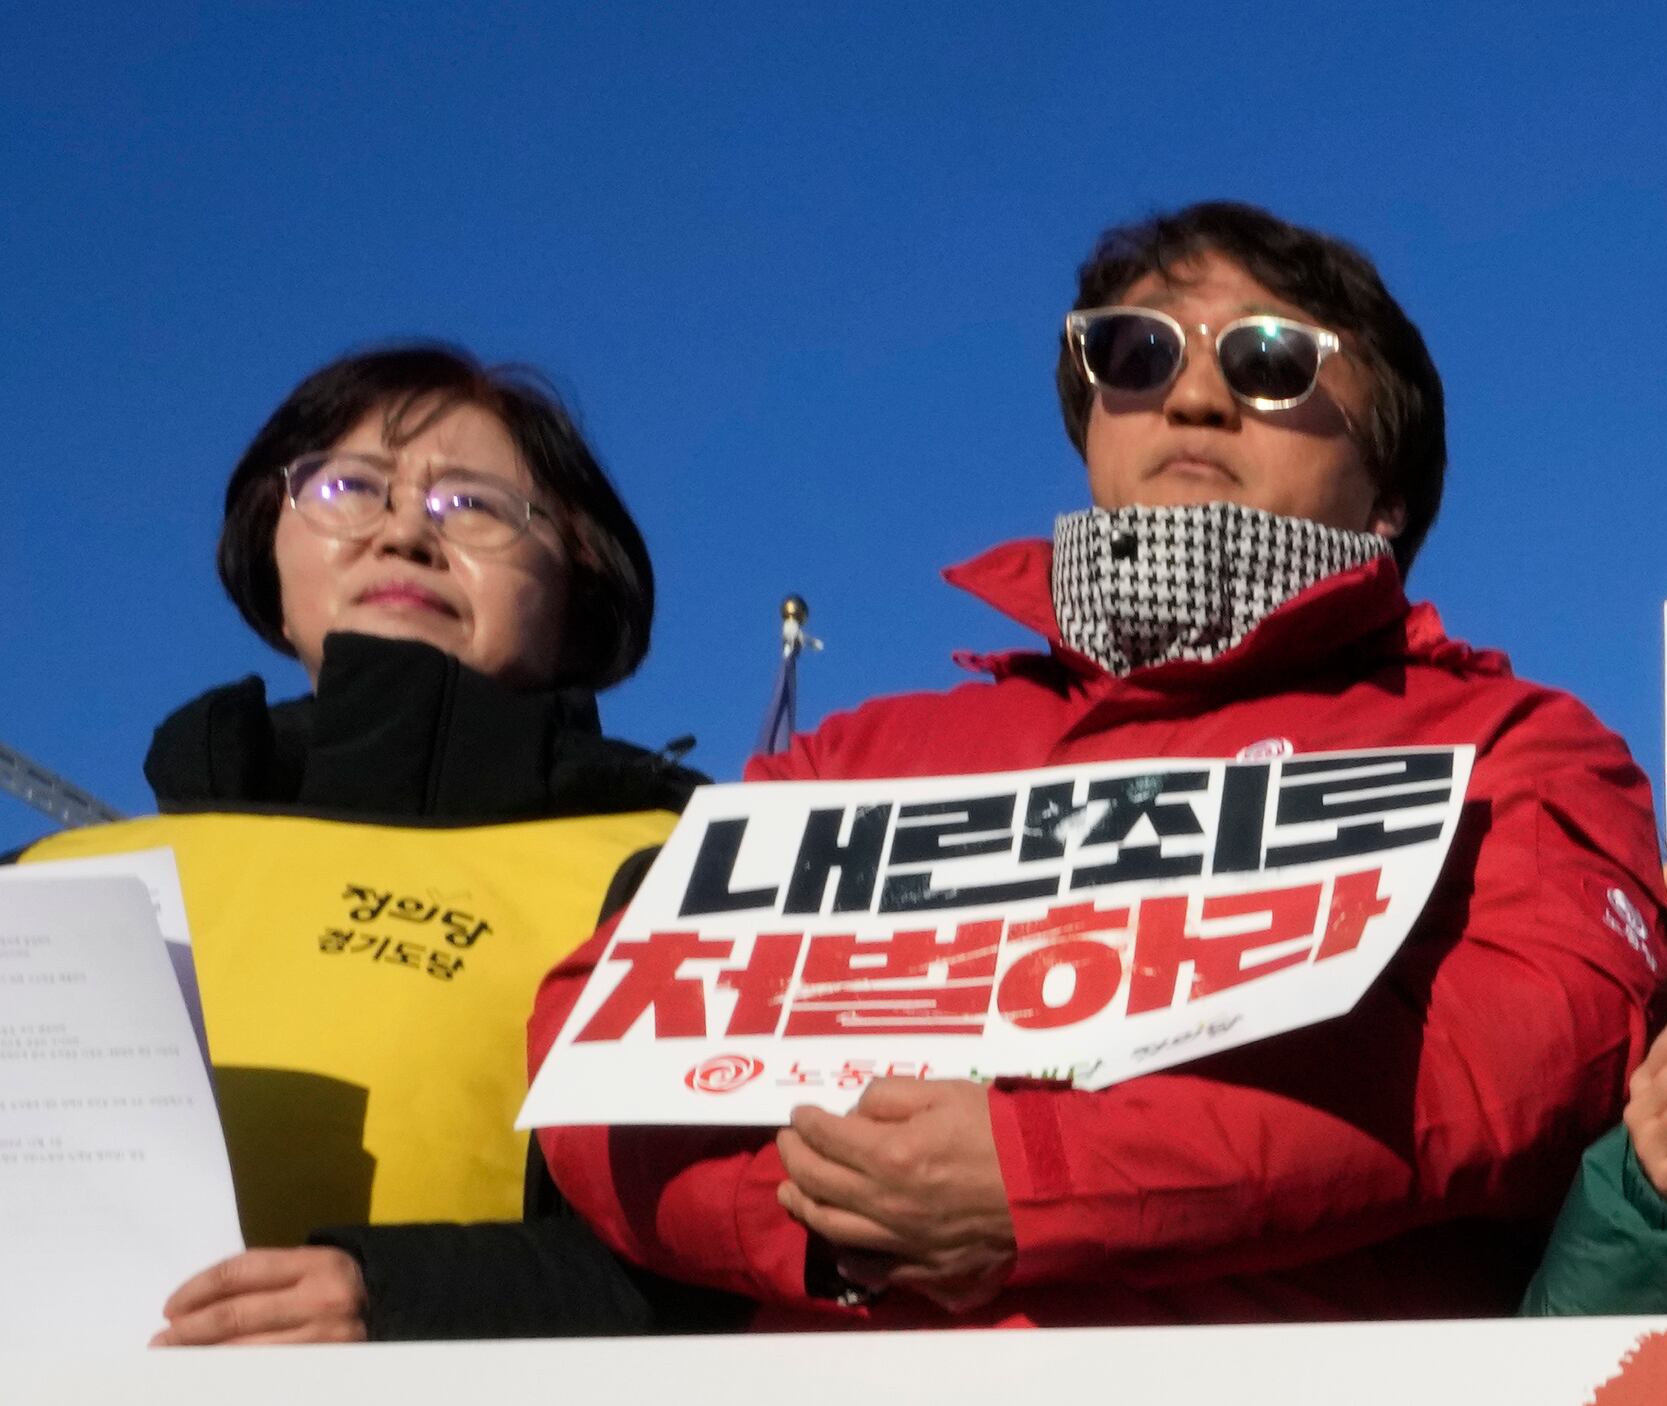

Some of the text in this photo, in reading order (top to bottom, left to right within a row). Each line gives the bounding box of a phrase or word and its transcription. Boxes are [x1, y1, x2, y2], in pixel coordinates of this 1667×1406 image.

[678, 752, 1454, 918] 내란죄로
[318, 926, 465, 982] 경기도당
[342, 884, 494, 949] 정의당
[572, 868, 1391, 1044] 처벌하라
